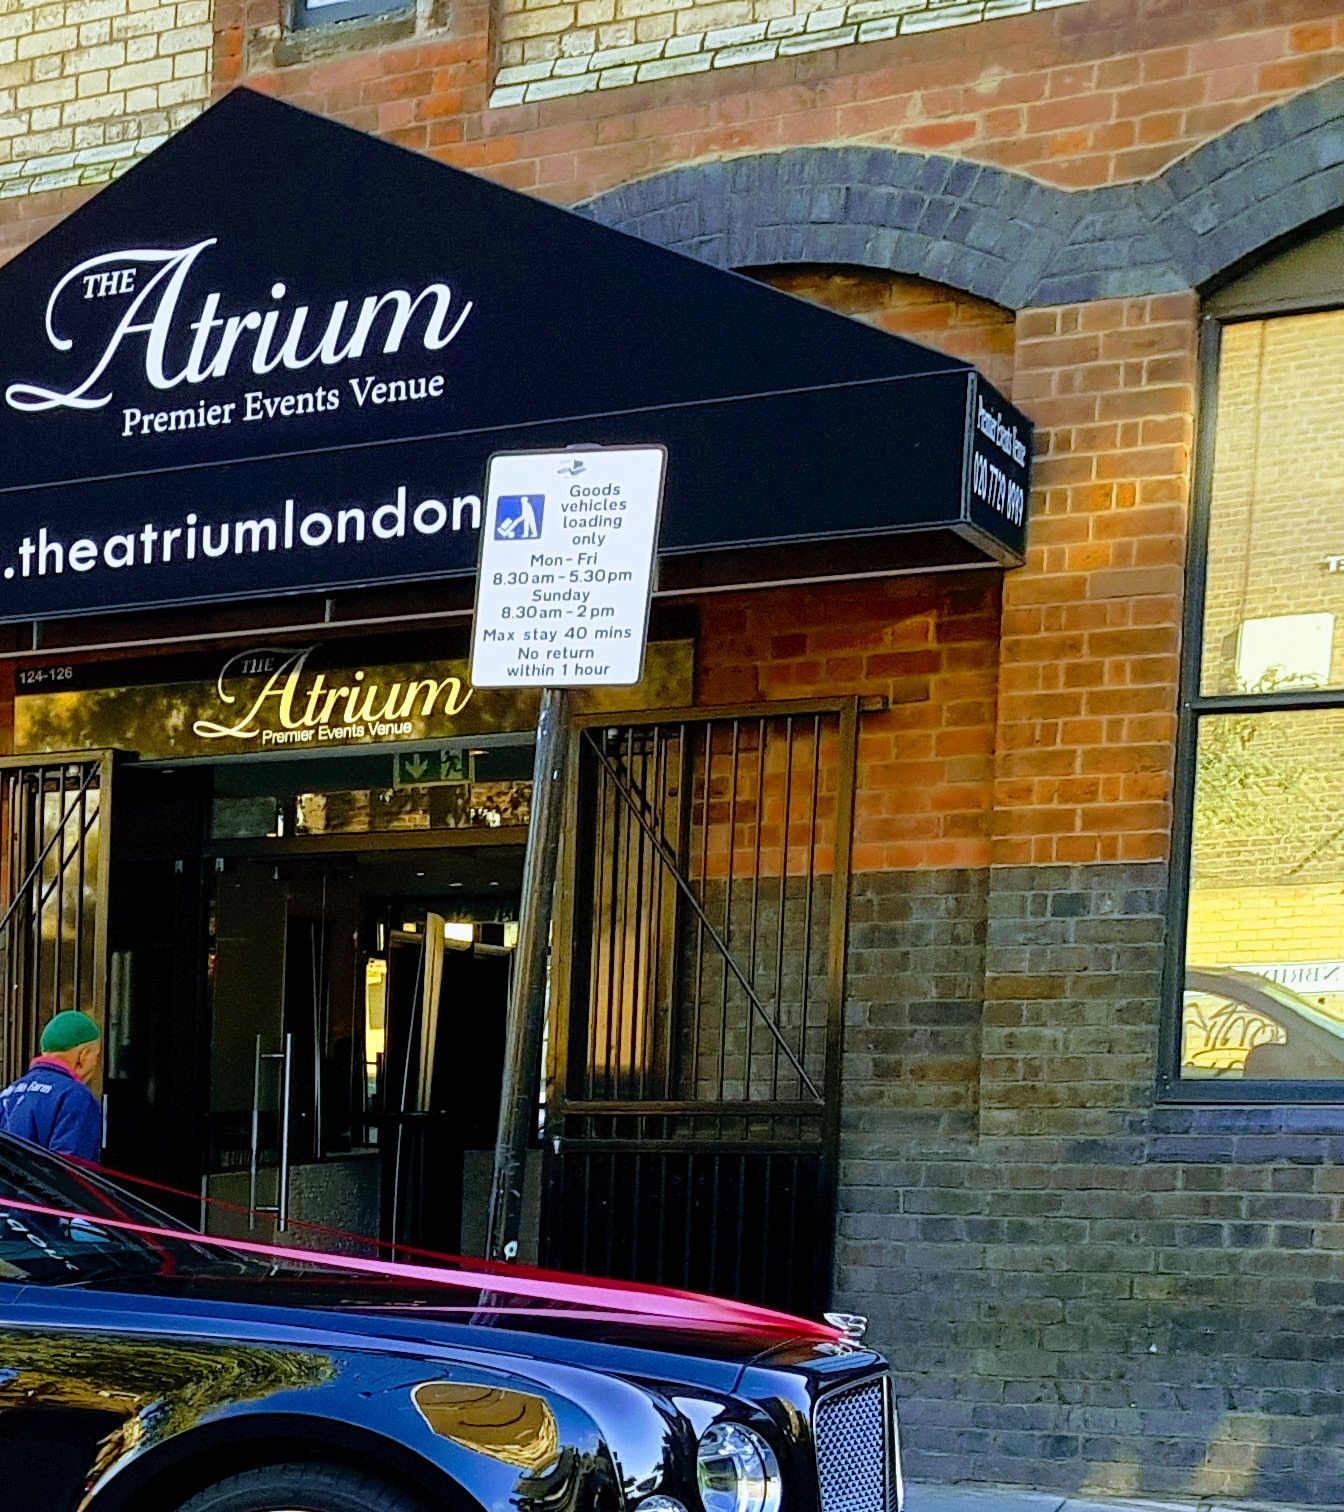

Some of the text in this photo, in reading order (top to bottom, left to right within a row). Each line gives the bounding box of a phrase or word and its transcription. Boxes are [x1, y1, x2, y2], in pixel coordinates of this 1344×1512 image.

[82, 267, 138, 300] THE
[6, 239, 473, 411] Atrium
[121, 374, 445, 437] Premier Events Venue
[569, 483, 621, 498] Goods
[560, 498, 627, 513] vehicles
[563, 515, 622, 529] loading
[572, 532, 606, 547] only
[532, 588, 591, 603] Sunday
[482, 626, 632, 643] Max stay 40 mins
[518, 647, 595, 660] No return
[241, 657, 274, 674] THE
[507, 663, 610, 677] within 1 hour
[19, 666, 73, 685] 124-126
[193, 643, 474, 738] Atrium
[262, 721, 412, 745] Premier Events Venue
